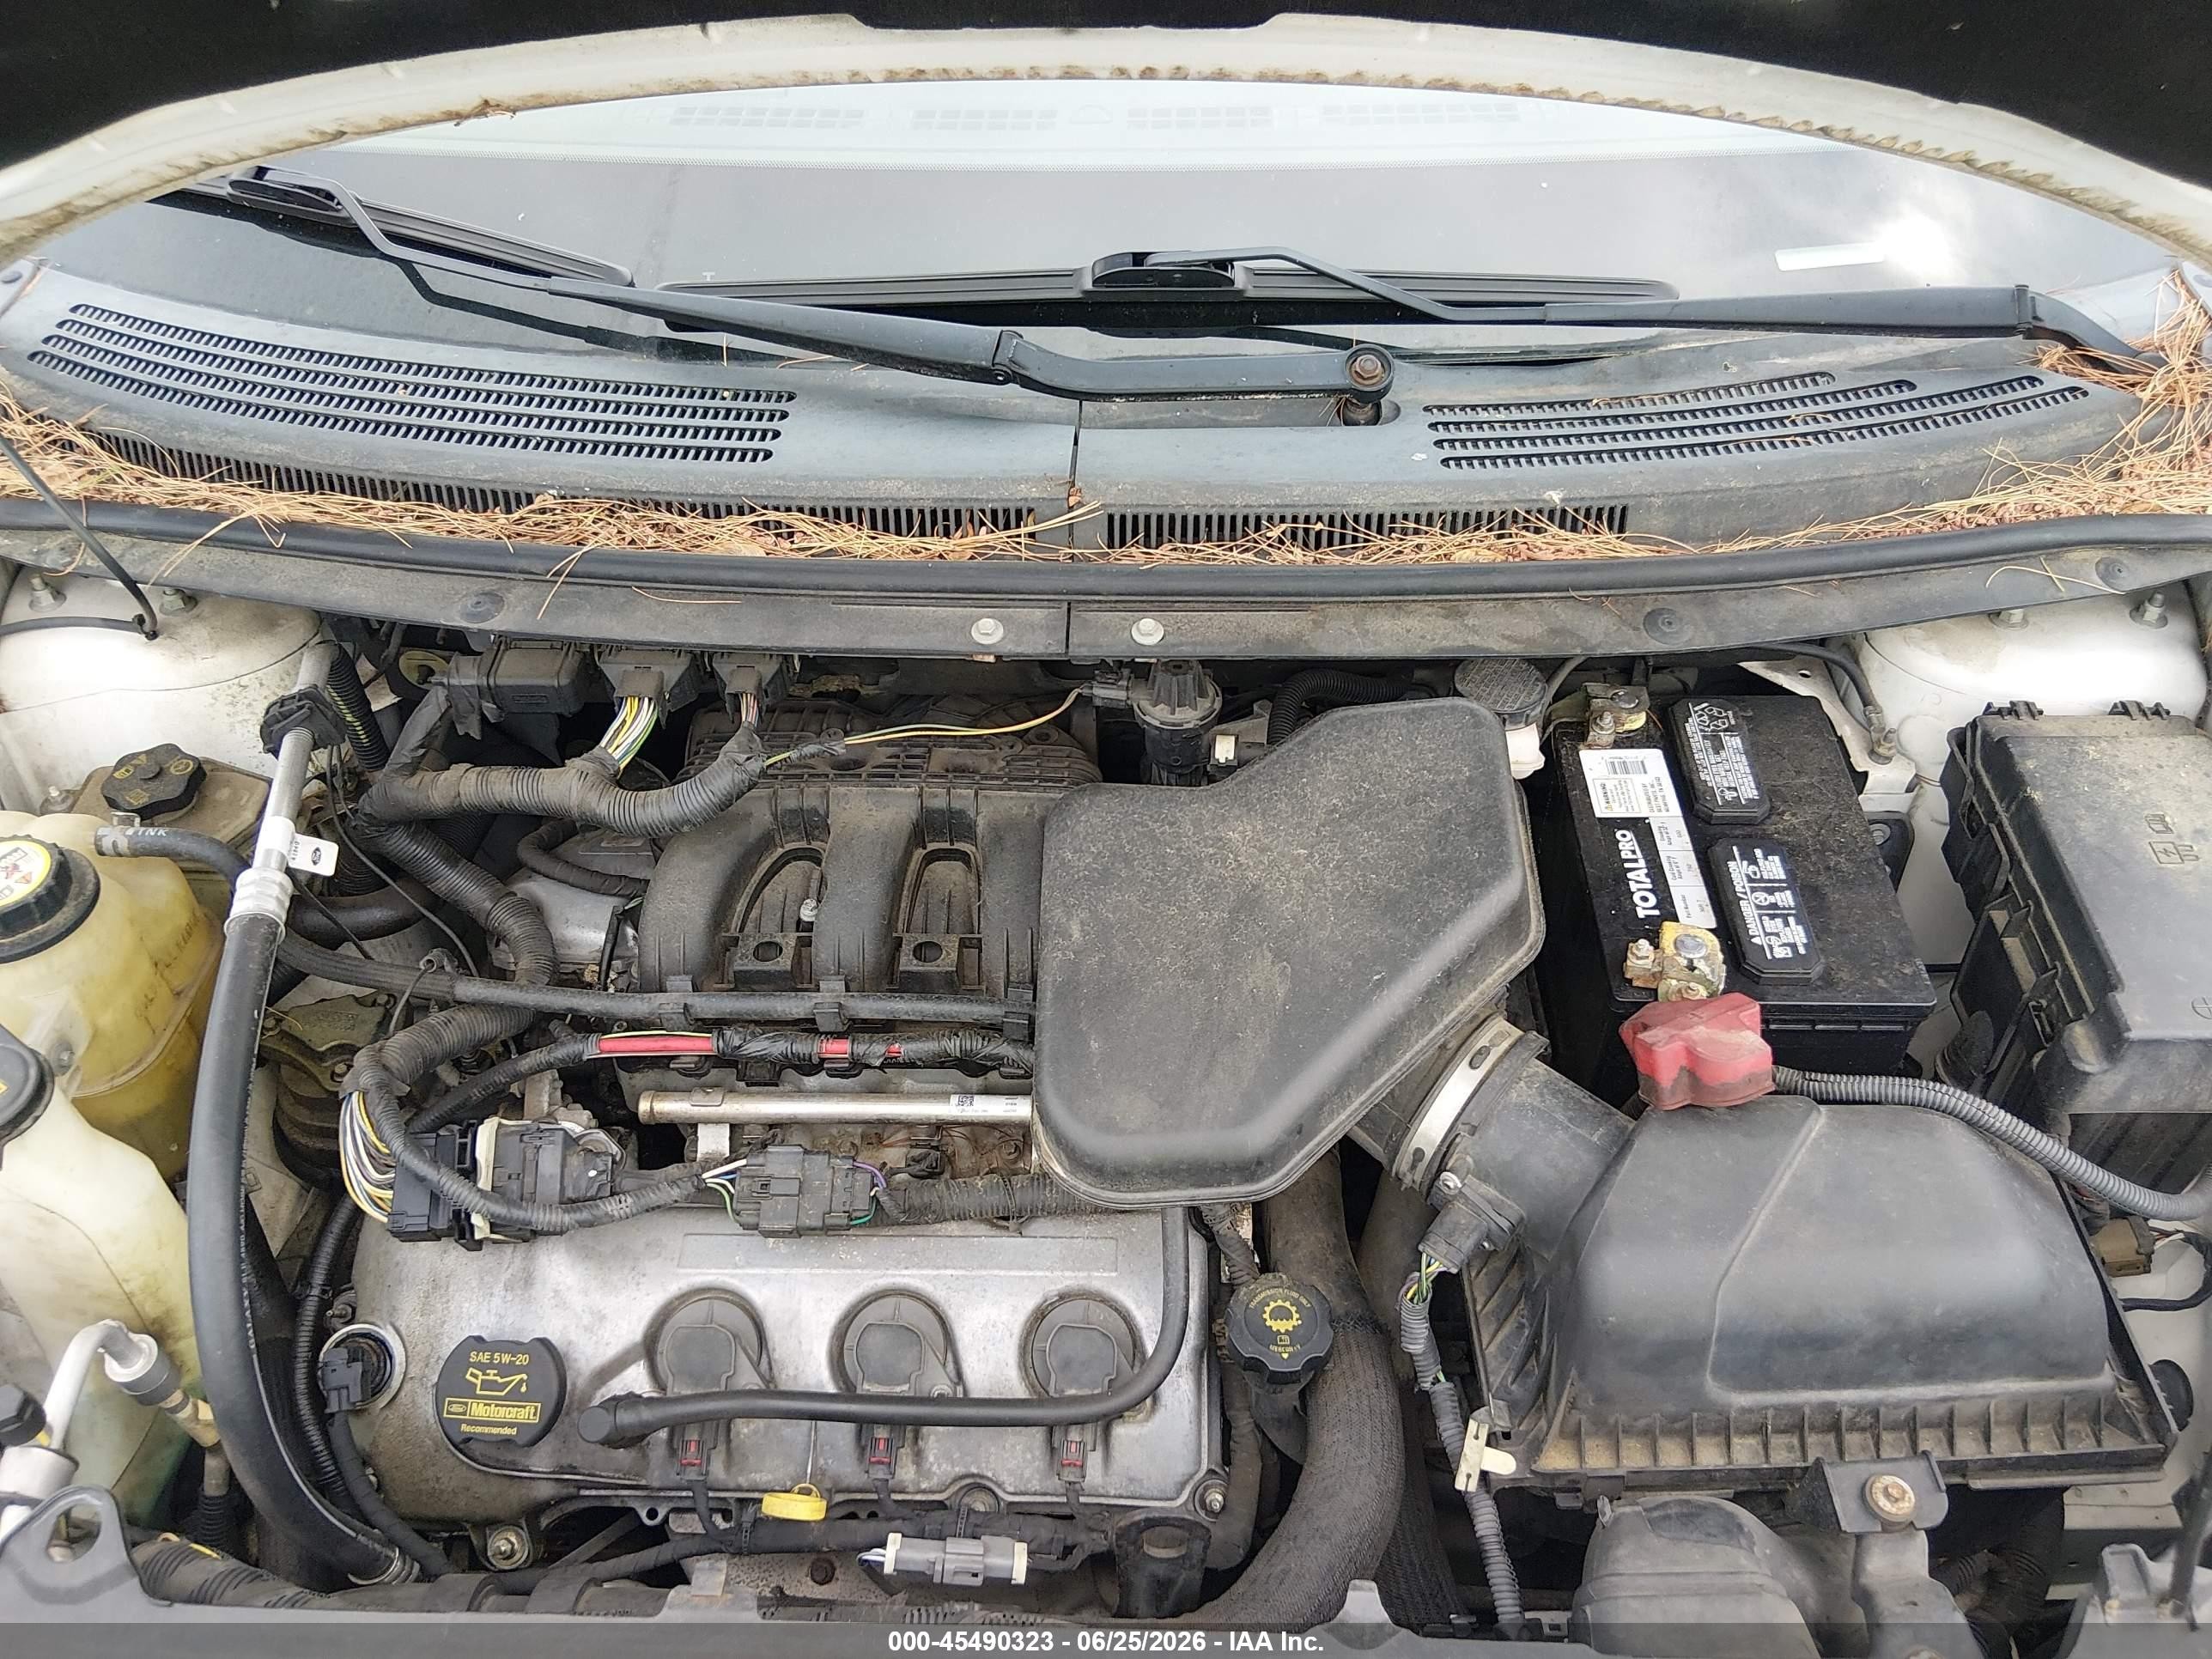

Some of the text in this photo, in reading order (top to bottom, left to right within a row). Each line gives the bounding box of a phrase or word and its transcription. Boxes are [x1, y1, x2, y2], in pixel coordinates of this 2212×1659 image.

[1616, 830, 1661, 919] TOTALPRO
[470, 1351, 530, 1365] SAE 5W-20
[471, 1402, 537, 1420] Motorcraft
[460, 1423, 518, 1436] Recommended
